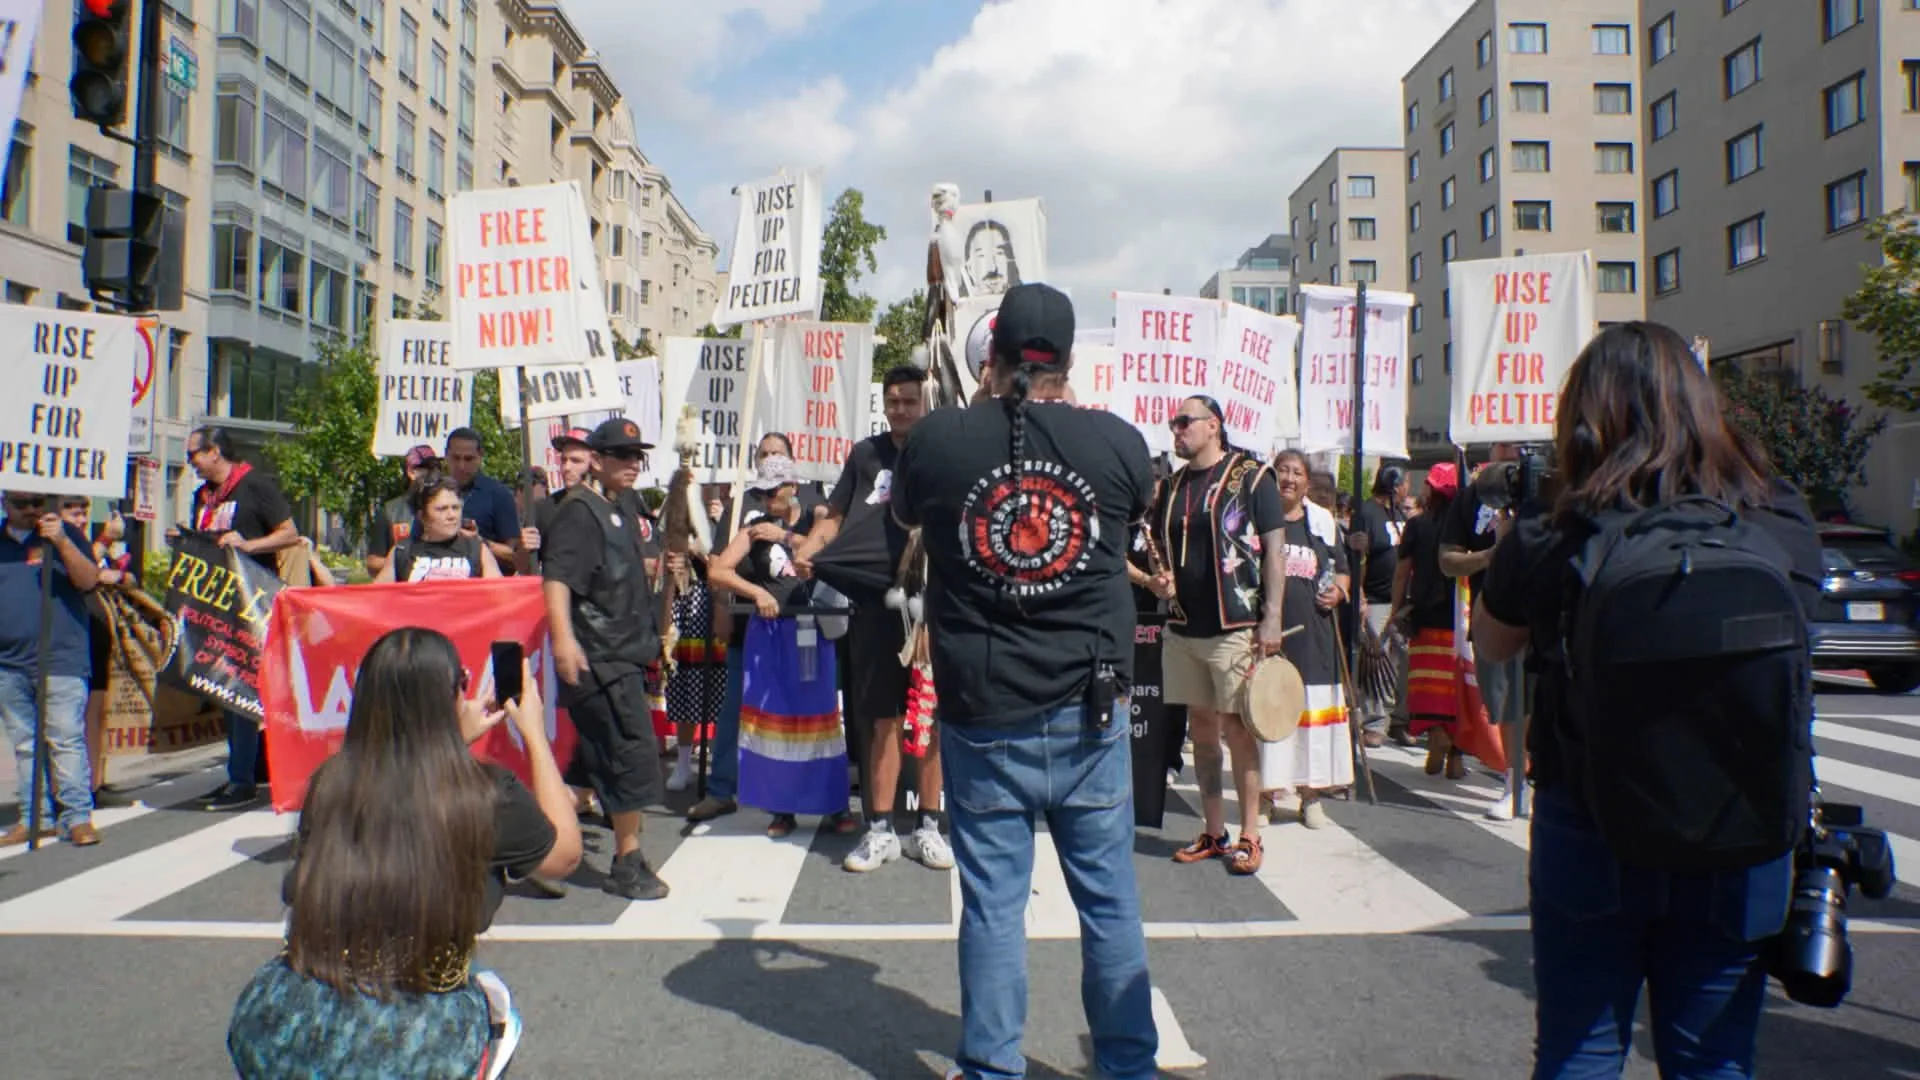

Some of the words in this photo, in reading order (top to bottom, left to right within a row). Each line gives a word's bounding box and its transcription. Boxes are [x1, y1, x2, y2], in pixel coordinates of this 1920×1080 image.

[757, 184, 796, 215] RISE
[480, 208, 547, 248] FREE
[761, 217, 785, 244] UP
[457, 256, 570, 298] PELTIER
[754, 248, 787, 276] FOR
[729, 277, 801, 310] PELTIER
[1494, 271, 1552, 304] RISE
[34, 321, 96, 360] RISE
[478, 308, 553, 348] NOW!
[1141, 309, 1193, 343] FREE
[1504, 311, 1538, 344] UP
[403, 339, 450, 366] FREE
[700, 345, 746, 372] RISE
[804, 329, 844, 360] RISE
[1241, 327, 1273, 366] FREE
[43, 364, 78, 398] UP
[812, 365, 834, 393] UP
[1122, 352, 1208, 387] PELTIER
[1222, 359, 1276, 405] PELTIER
[1496, 352, 1544, 384] FOR
[384, 375, 463, 402] PELTIER
[524, 368, 597, 405] NOW!
[708, 377, 734, 403] UP
[31, 403, 82, 438] FOR
[396, 411, 449, 438] NOW!
[701, 409, 739, 437] FOR
[804, 399, 837, 430] FOR
[1134, 395, 1186, 425] NOW
[1223, 402, 1261, 435] NOW!
[1469, 392, 1556, 425] PELTIE
[0, 441, 107, 481] PELTIER
[992, 459, 1063, 479] WONDED
[167, 551, 241, 611] FREE
